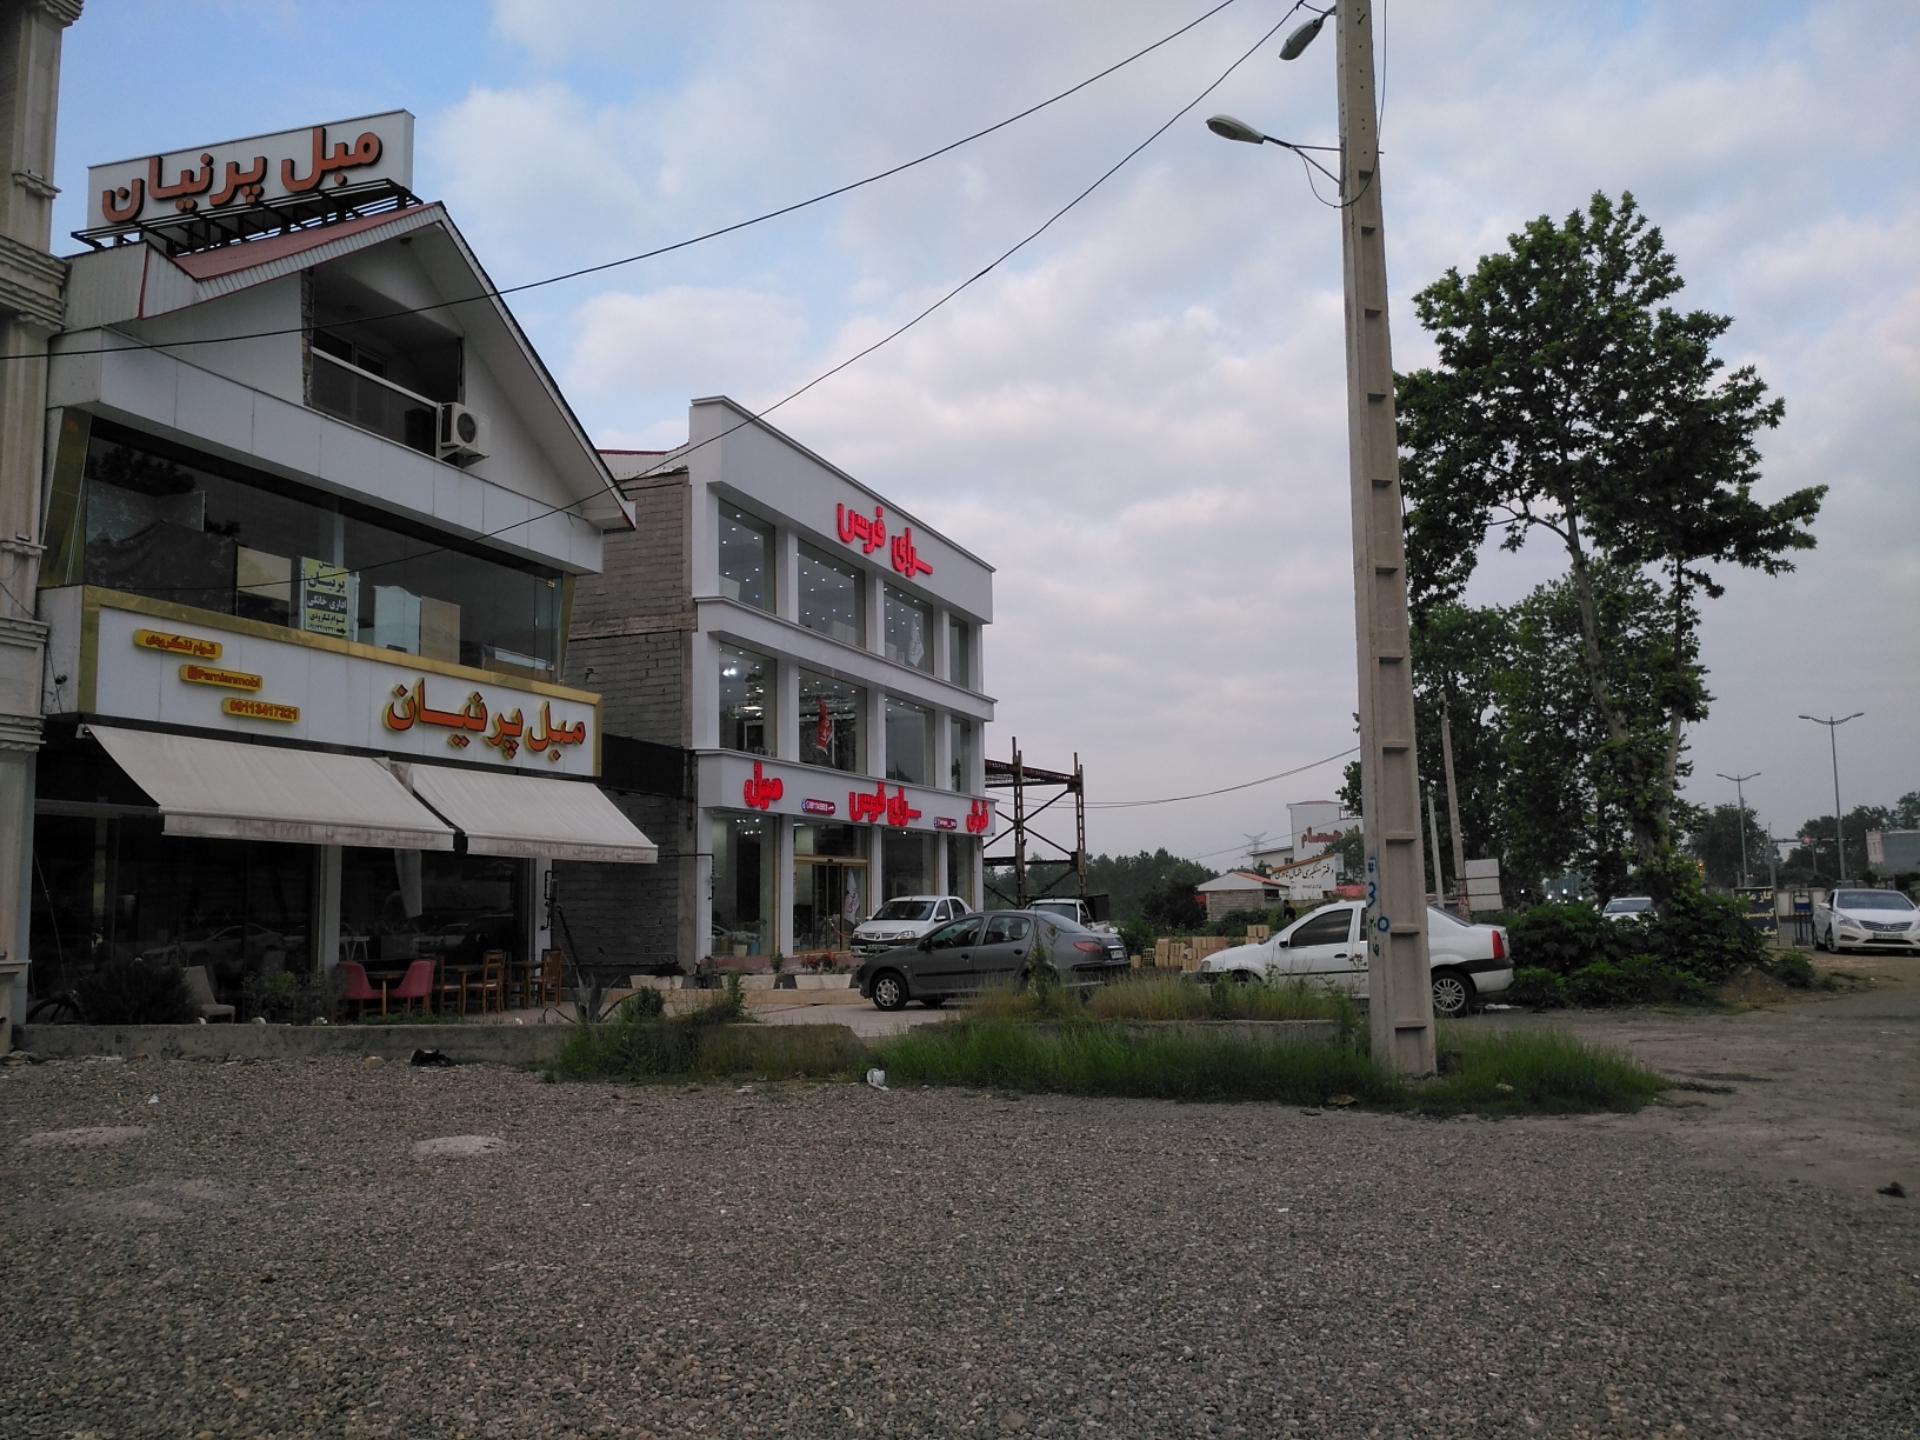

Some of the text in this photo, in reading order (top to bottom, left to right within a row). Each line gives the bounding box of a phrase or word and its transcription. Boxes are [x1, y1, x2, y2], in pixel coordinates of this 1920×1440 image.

[102, 127, 382, 223] مبل پرنیان
[383, 677, 586, 760] مبل پرنیان
[744, 760, 783, 810] مبل
